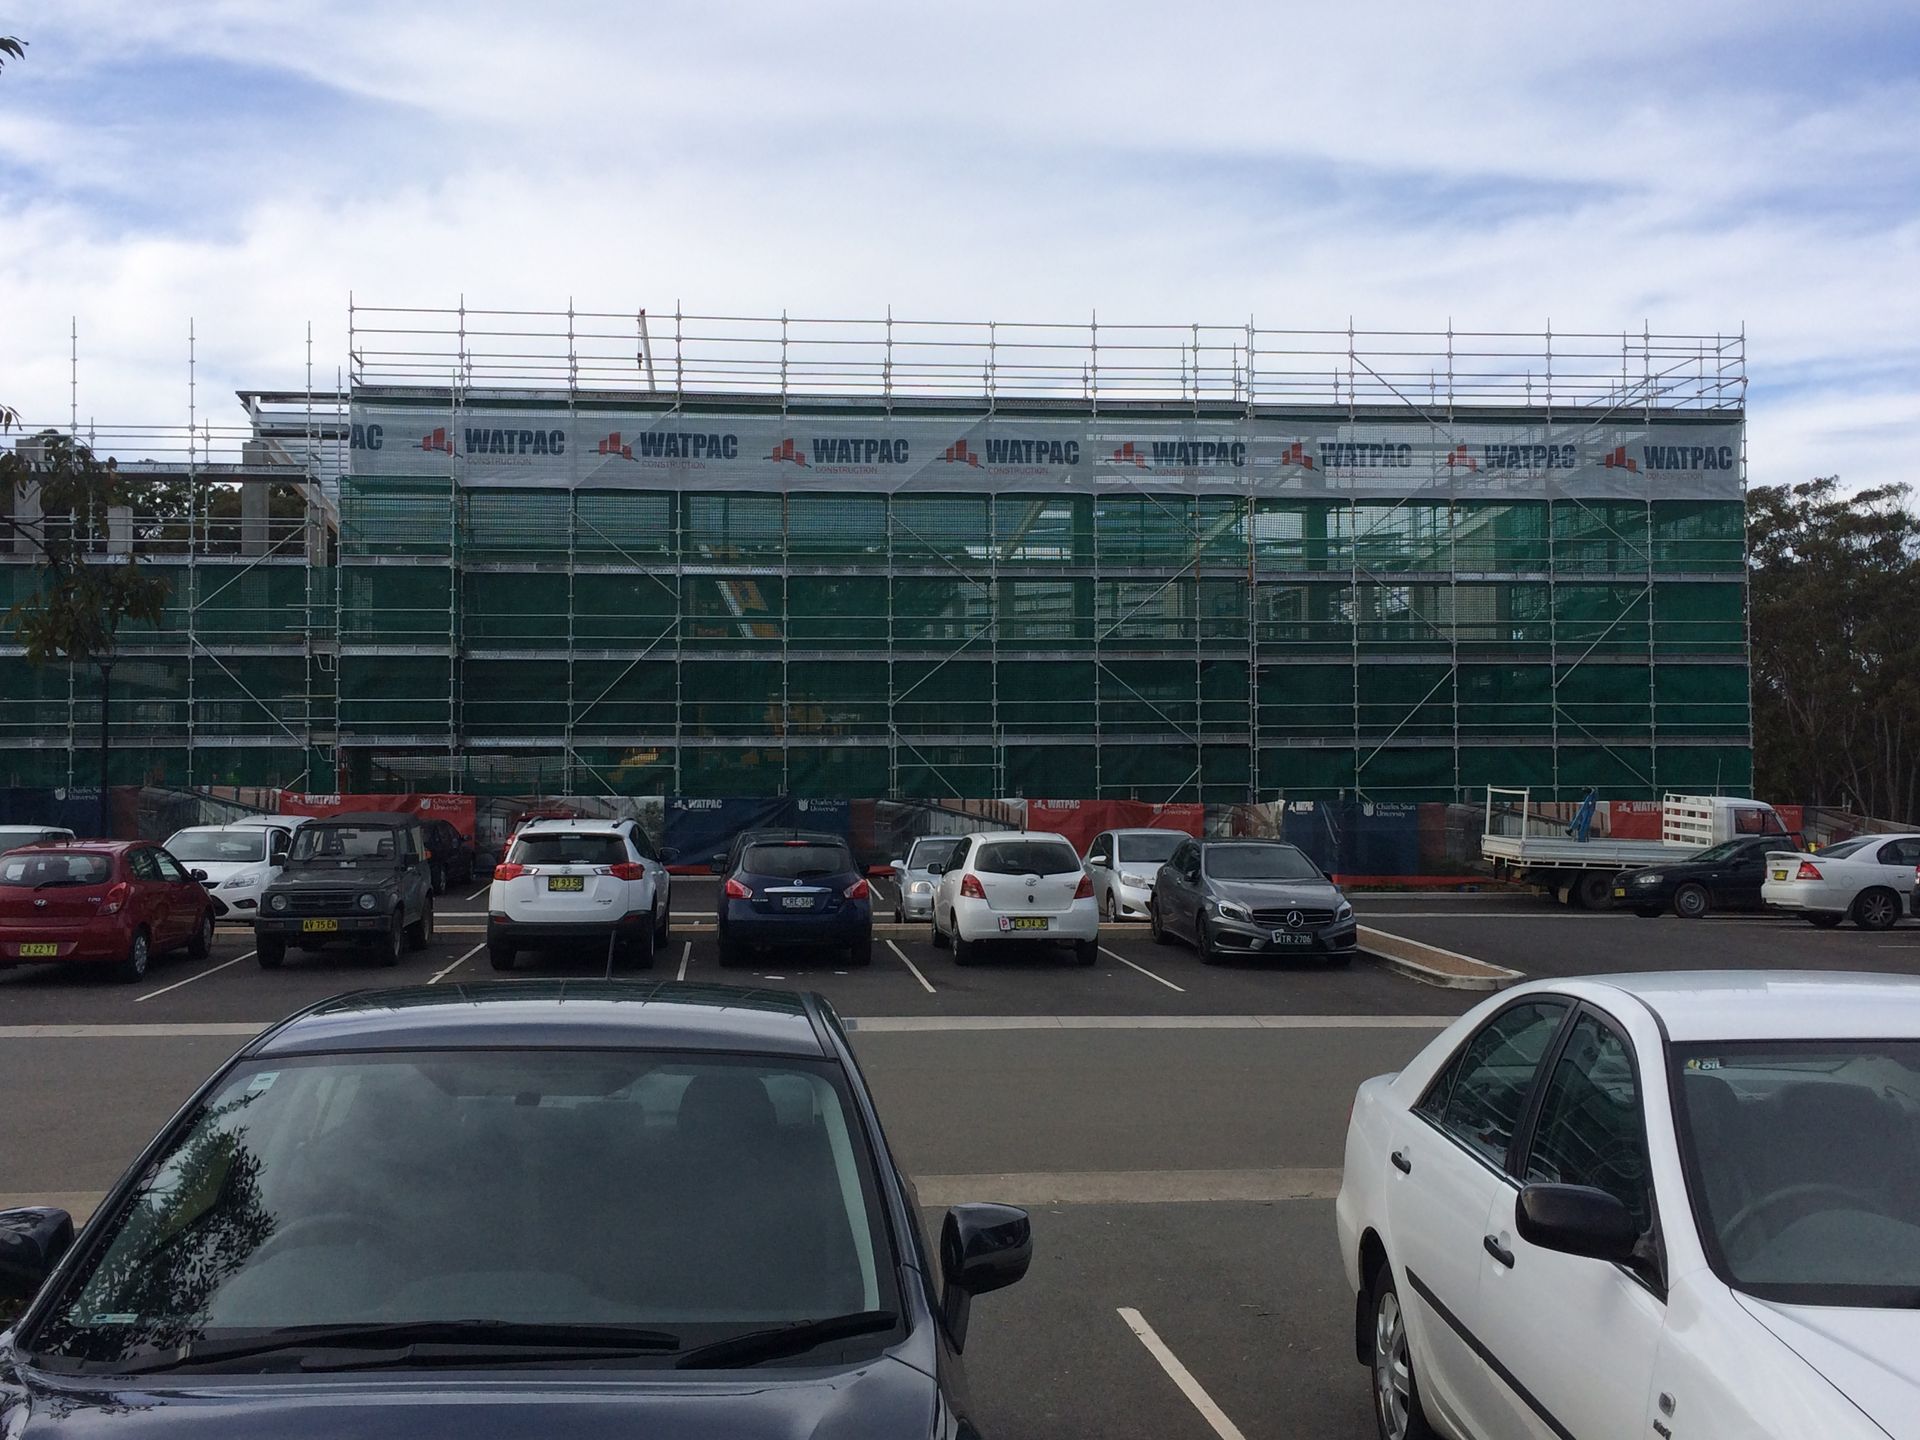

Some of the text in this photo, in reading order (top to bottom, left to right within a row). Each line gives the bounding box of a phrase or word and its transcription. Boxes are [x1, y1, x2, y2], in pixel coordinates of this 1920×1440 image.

[465, 428, 565, 455] WATPAC
[640, 432, 738, 459] WATPAC
[812, 438, 909, 463] WATPAC
[985, 439, 1080, 465] WATPAC
[1152, 441, 1246, 467] WATPAC
[1320, 443, 1412, 468] WATPAC
[1484, 444, 1576, 469] WATPAC
[1643, 445, 1733, 470] WATPAC
[815, 465, 878, 475] CONSTRUCTION
[304, 794, 341, 805] WATPAC
[688, 799, 722, 809] WATPAC
[1047, 799, 1080, 809] WATPAC
